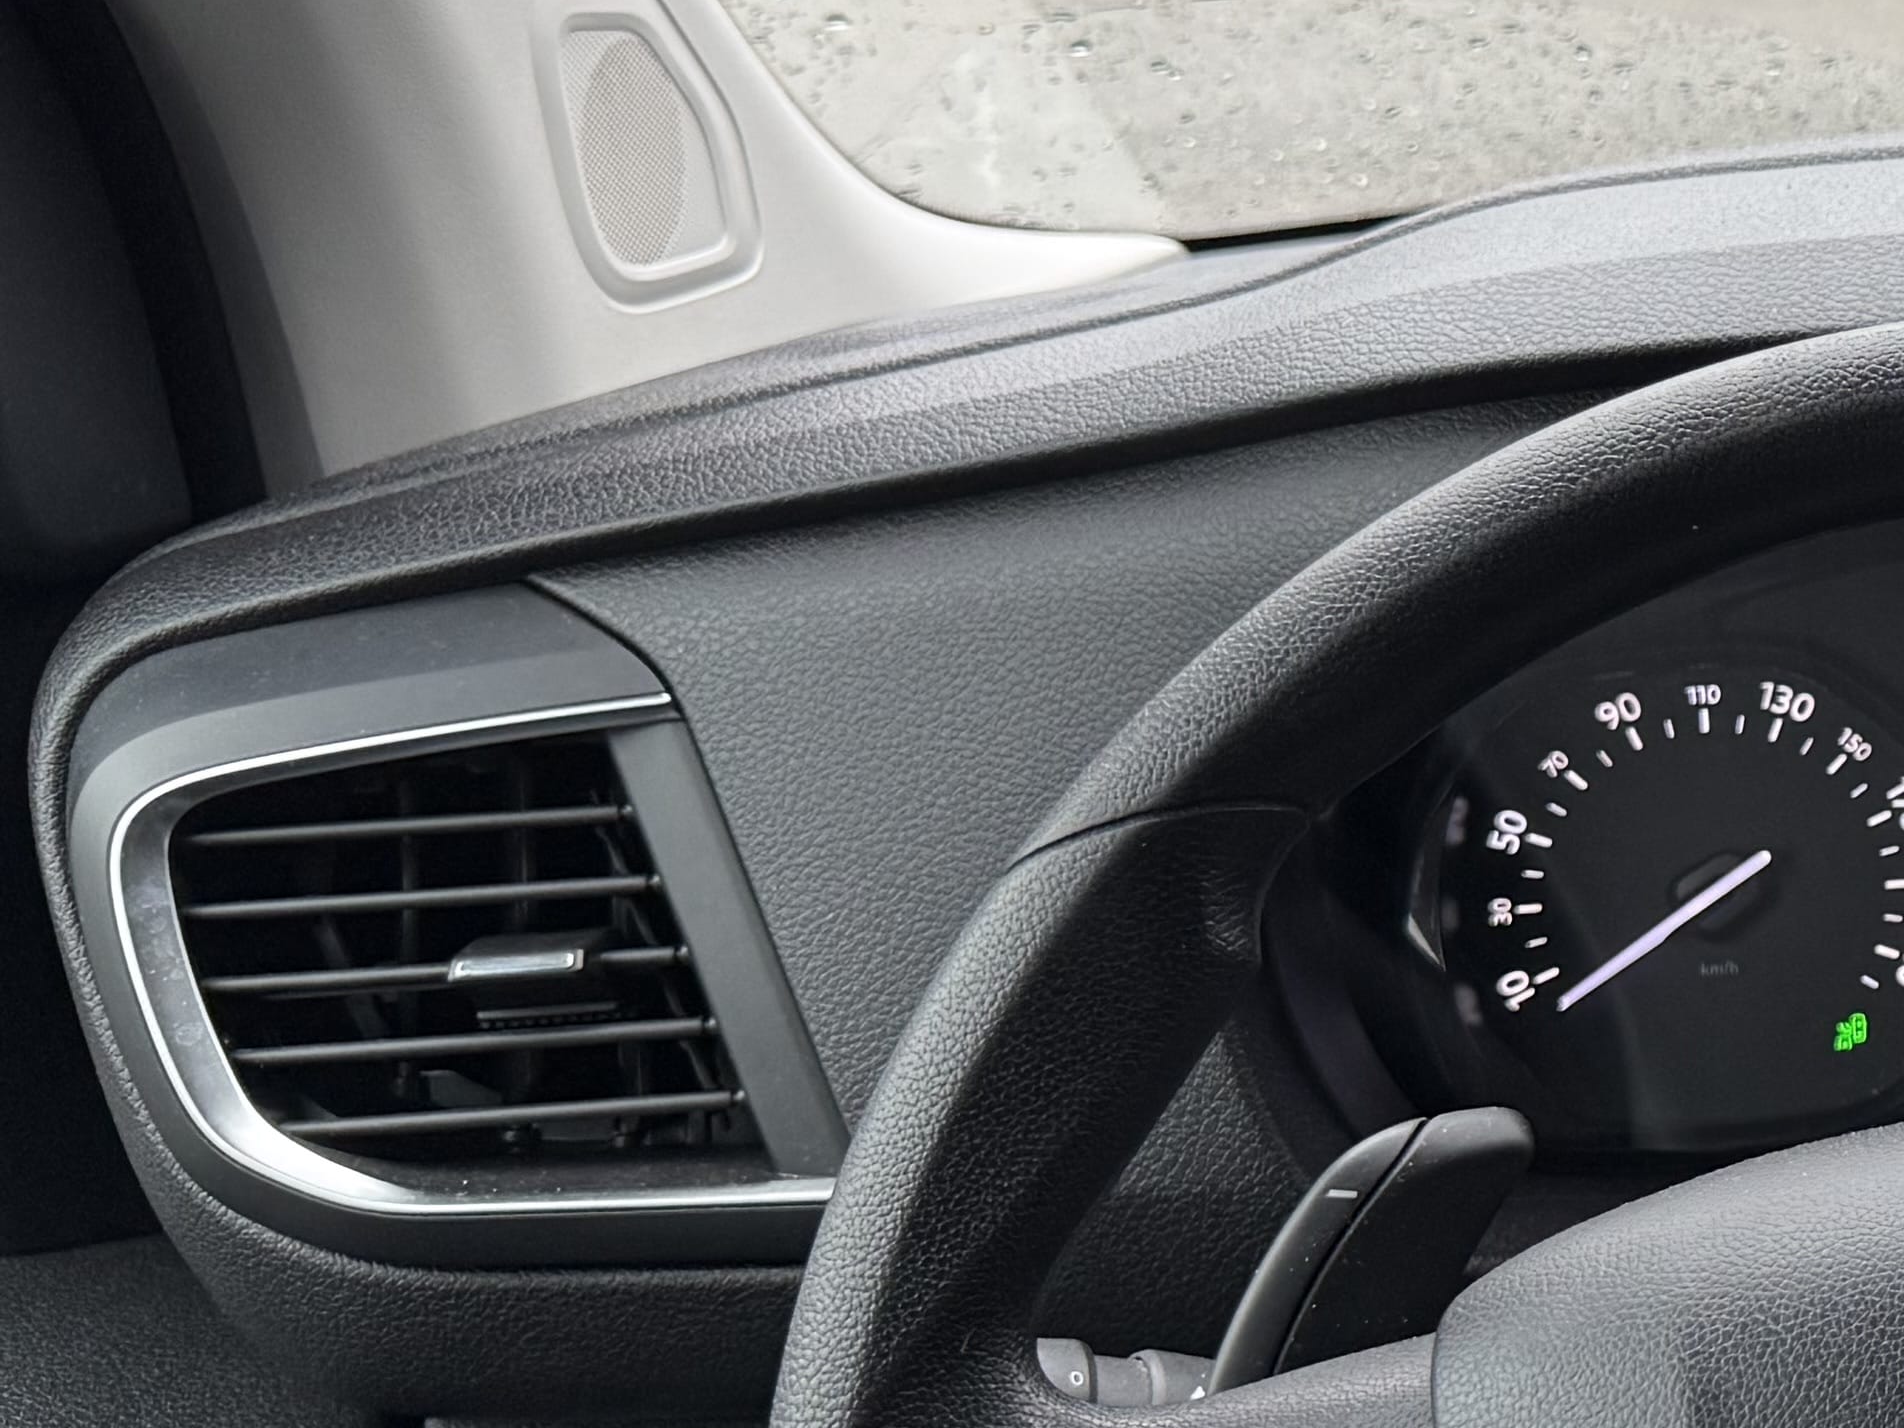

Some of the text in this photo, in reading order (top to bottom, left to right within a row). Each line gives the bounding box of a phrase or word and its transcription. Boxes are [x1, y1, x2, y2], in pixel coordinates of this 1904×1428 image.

[1595, 692, 1641, 730] 90
[1684, 684, 1721, 706] 110
[1760, 682, 1815, 722] 130
[1838, 727, 1872, 762] 150
[1538, 750, 1569, 777] 70
[1486, 810, 1527, 855] 50
[1488, 898, 1512, 926] 30
[1497, 970, 1536, 1011] 10
